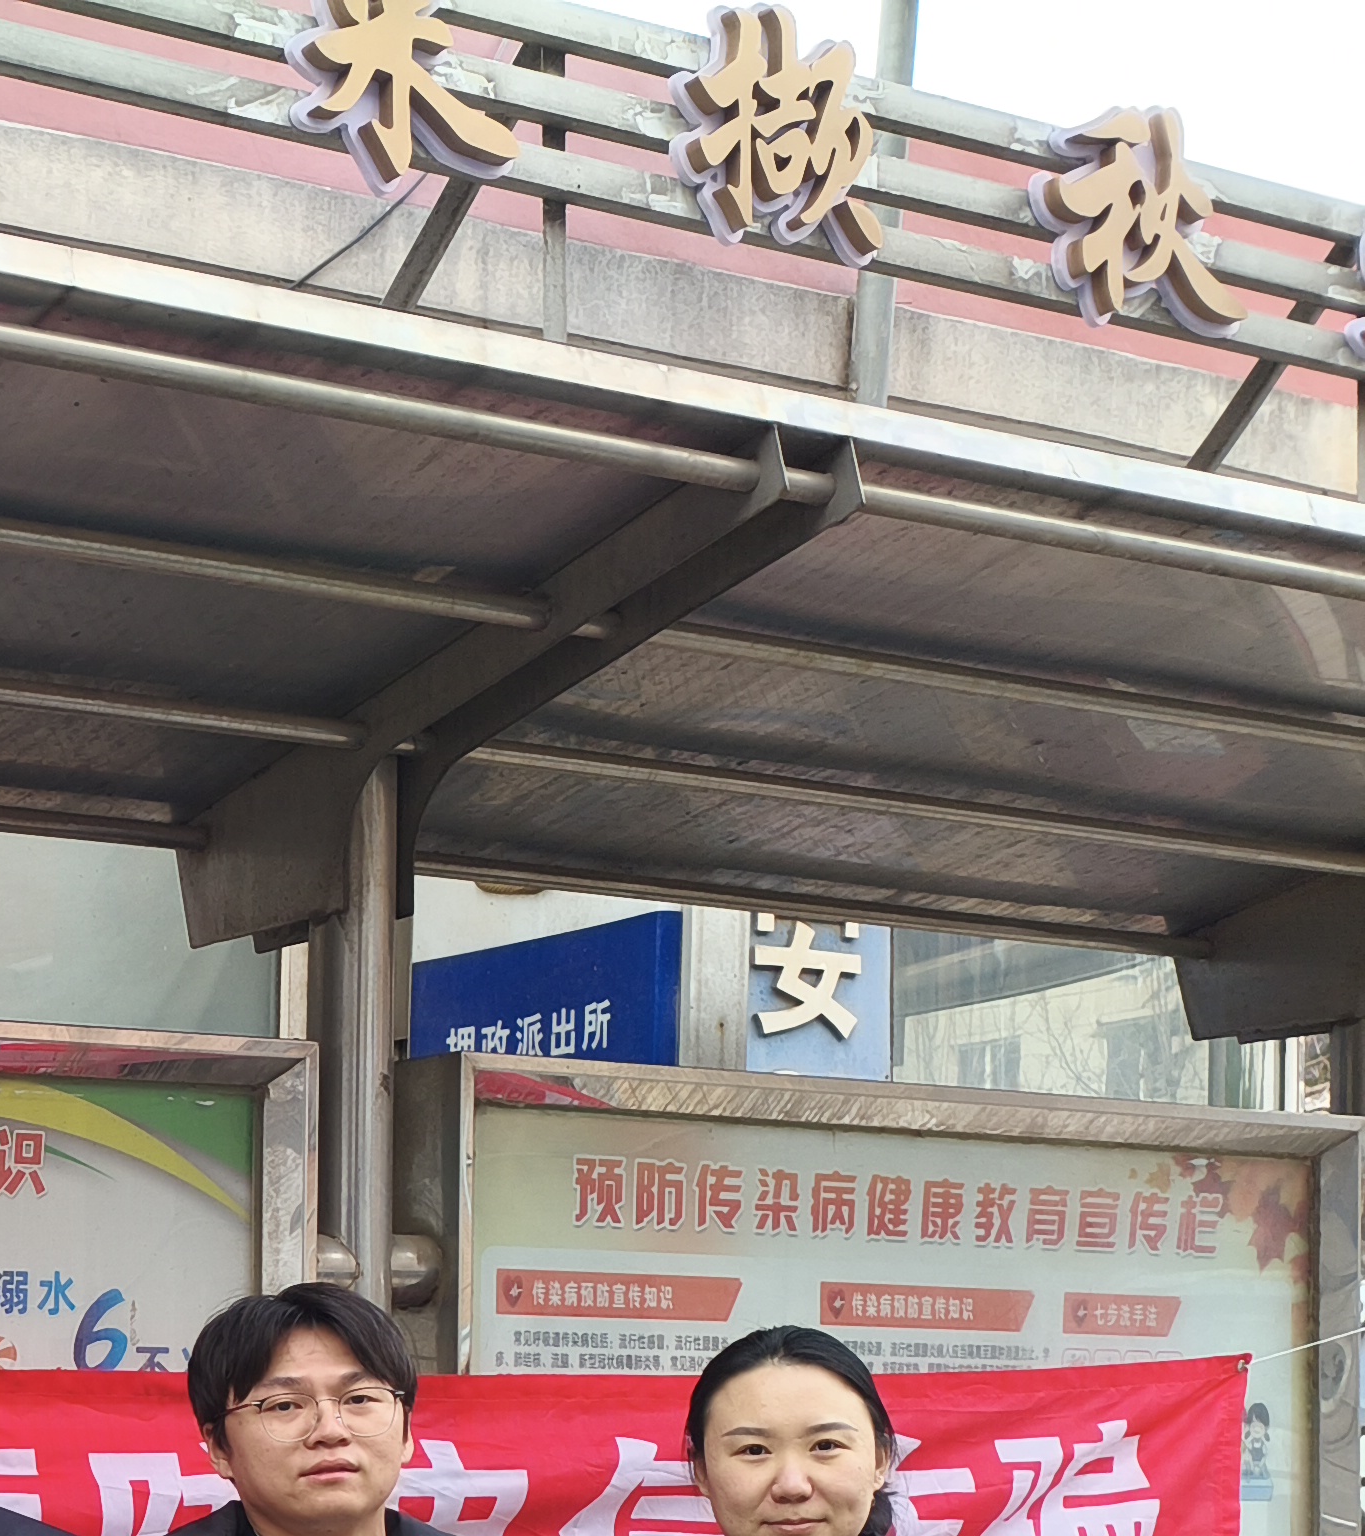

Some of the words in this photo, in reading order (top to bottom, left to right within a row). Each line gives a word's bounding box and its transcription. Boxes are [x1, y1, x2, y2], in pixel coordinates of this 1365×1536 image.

[574, 1156, 1222, 1255] 预防传染病健康教育宣传栏
[532, 1280, 673, 1310] 传染病预防宣传知识
[852, 1292, 974, 1320] 传染病预防宣传知识
[1094, 1303, 1159, 1328] 七步洗手法
